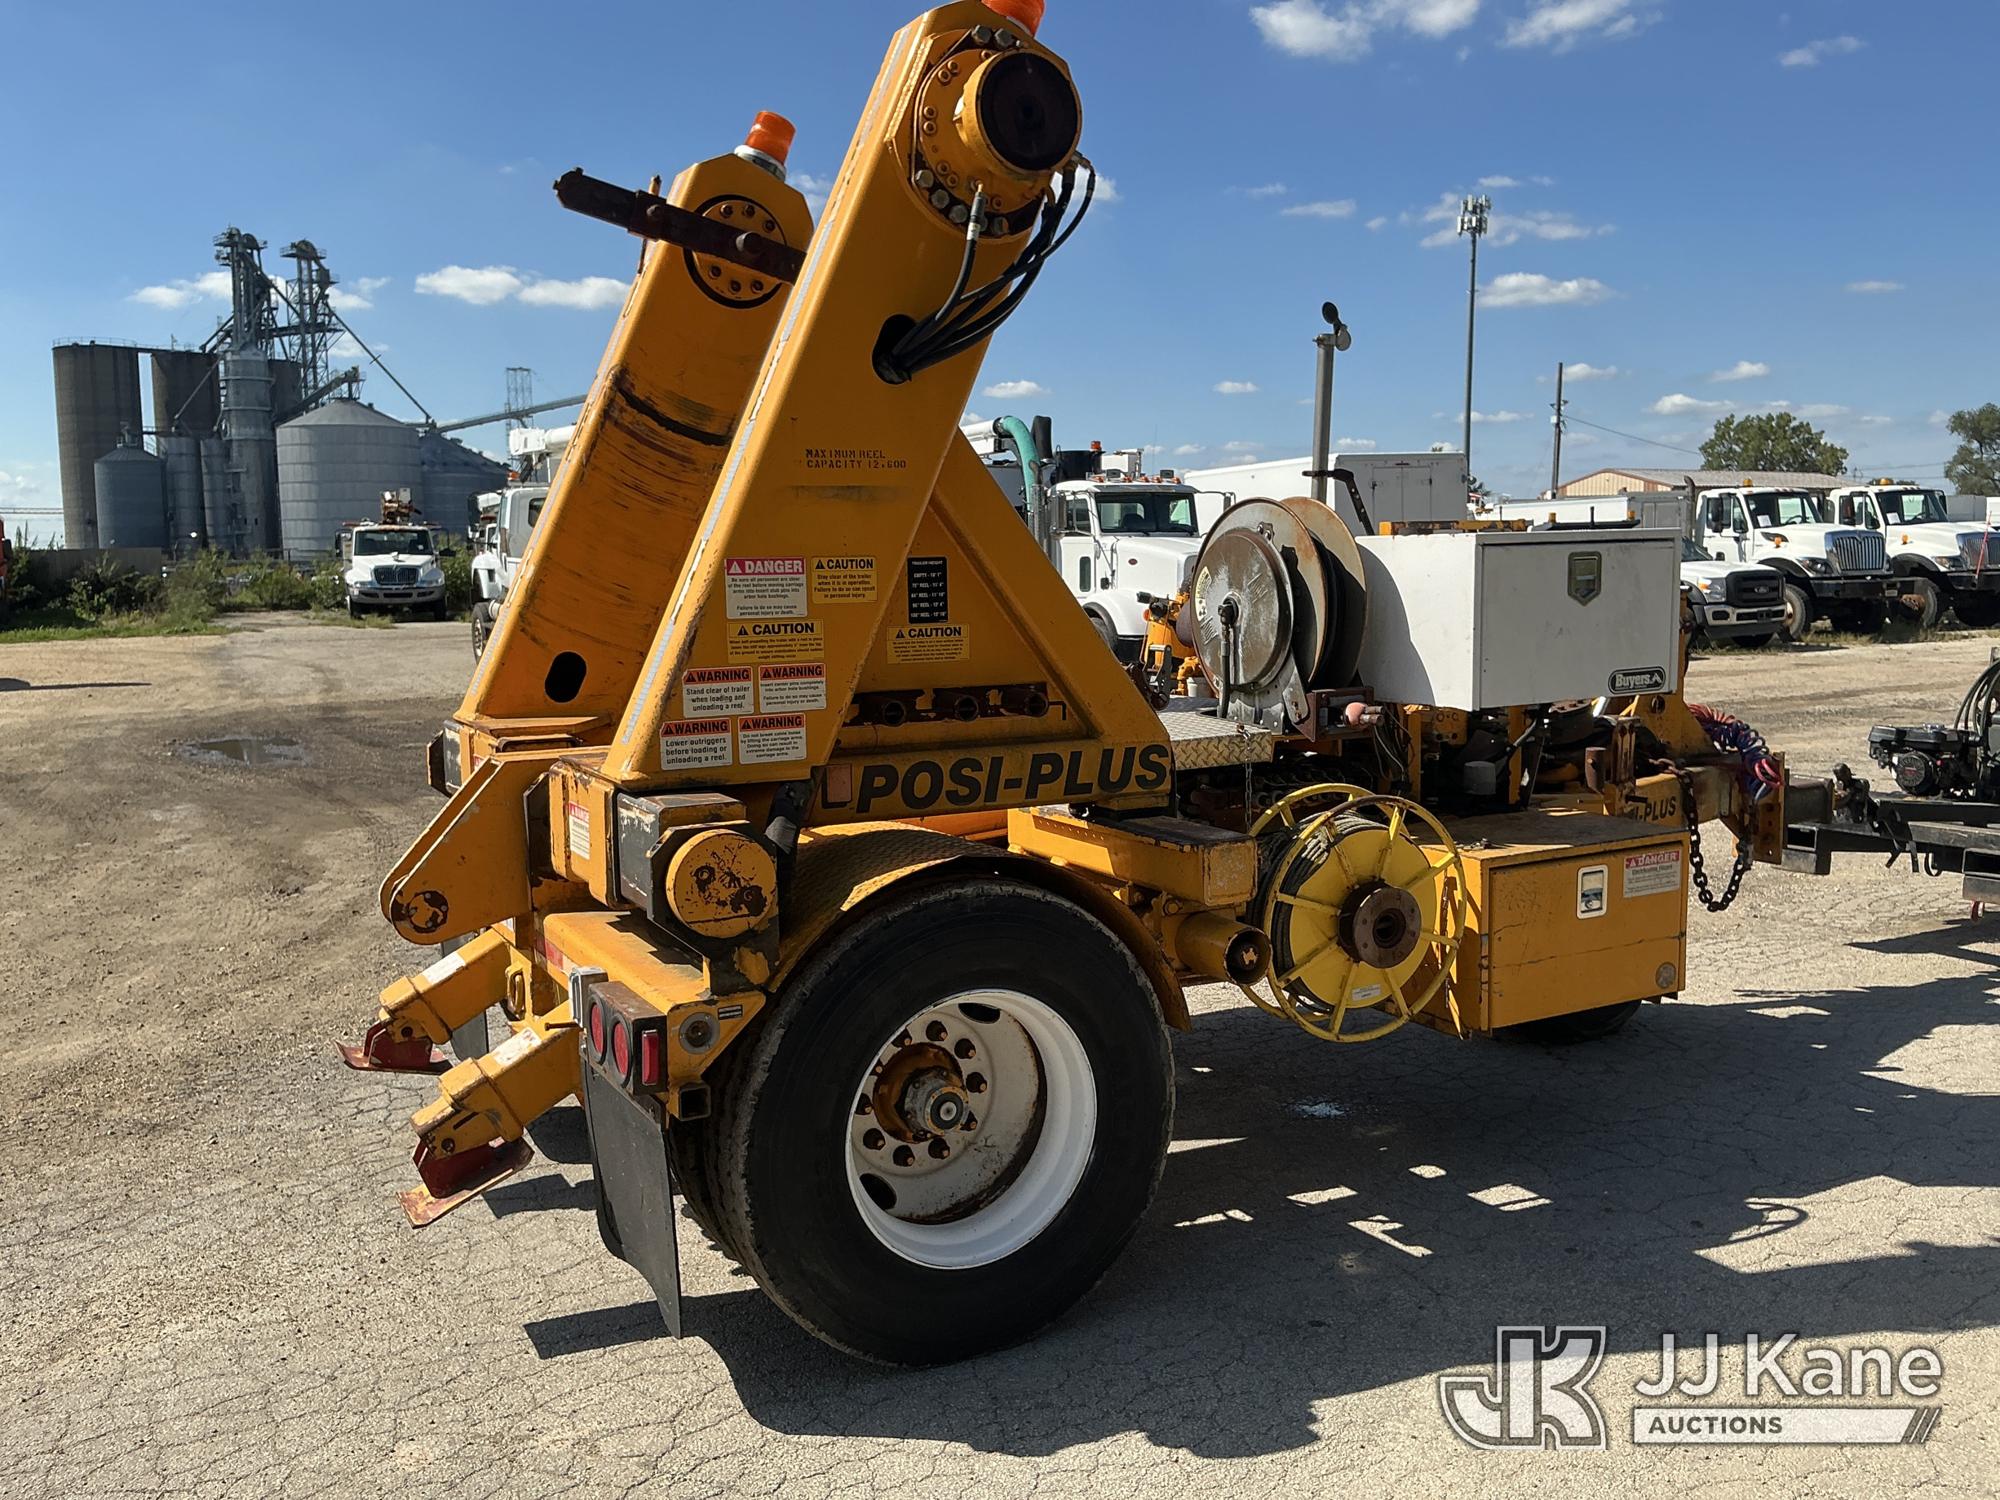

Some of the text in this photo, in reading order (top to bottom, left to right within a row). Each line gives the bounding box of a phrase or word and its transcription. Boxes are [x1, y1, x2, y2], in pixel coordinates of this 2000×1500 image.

[859, 450, 885, 459] REEL
[807, 459, 862, 469] CAPACITY
[745, 560, 803, 574] DANGER
[827, 558, 873, 569] CAUTION
[753, 623, 814, 635] CAUTION
[908, 627, 961, 638] CAUTION
[697, 669, 750, 682] WARNING
[773, 665, 822, 678] WARNING
[1615, 673, 1651, 689] Buyers
[693, 704, 723, 712] unloading
[675, 720, 728, 734] WARNING
[752, 716, 802, 729] WARNING
[690, 737, 726, 745] outriggers
[691, 746, 717, 754] loading
[666, 756, 702, 764] unloading
[711, 753, 727, 761] reel.
[856, 743, 1170, 814] POSI-PLUS
[1638, 852, 1677, 866] DANGER
